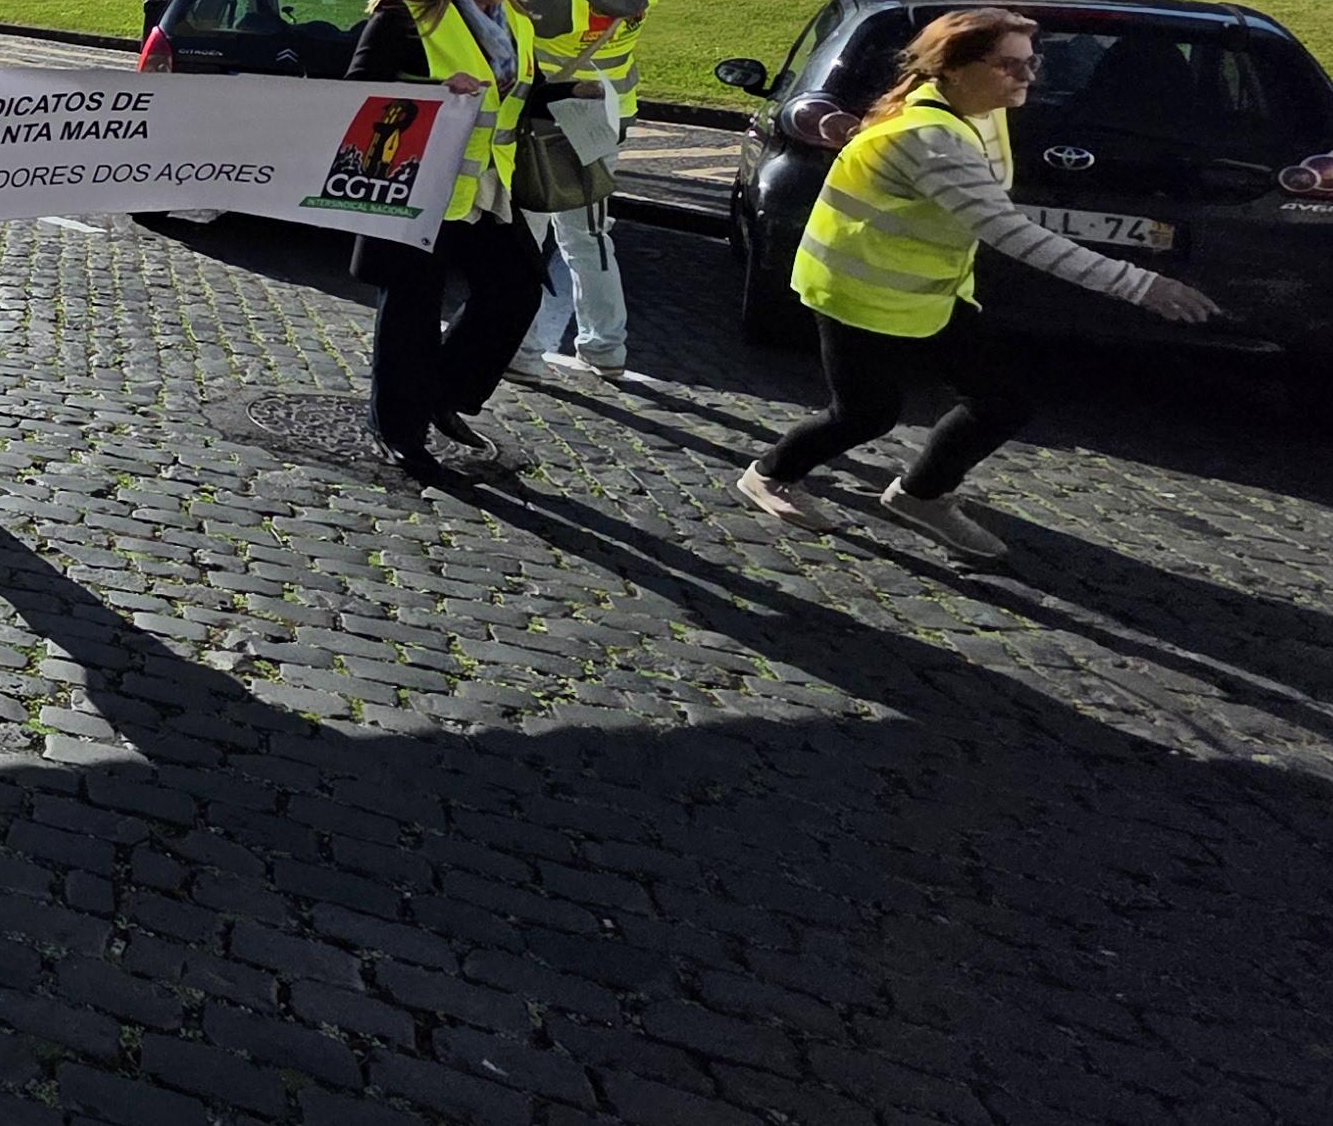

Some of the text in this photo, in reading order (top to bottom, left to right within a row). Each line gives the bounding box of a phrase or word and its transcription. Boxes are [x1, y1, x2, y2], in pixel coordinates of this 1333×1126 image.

[111, 92, 154, 111] DE
[59, 120, 148, 140] MARIA
[92, 163, 151, 183] DOS
[154, 163, 275, 185] AÇORES
[326, 173, 409, 204] CGTP
[369, 204, 415, 217] NACIONAL
